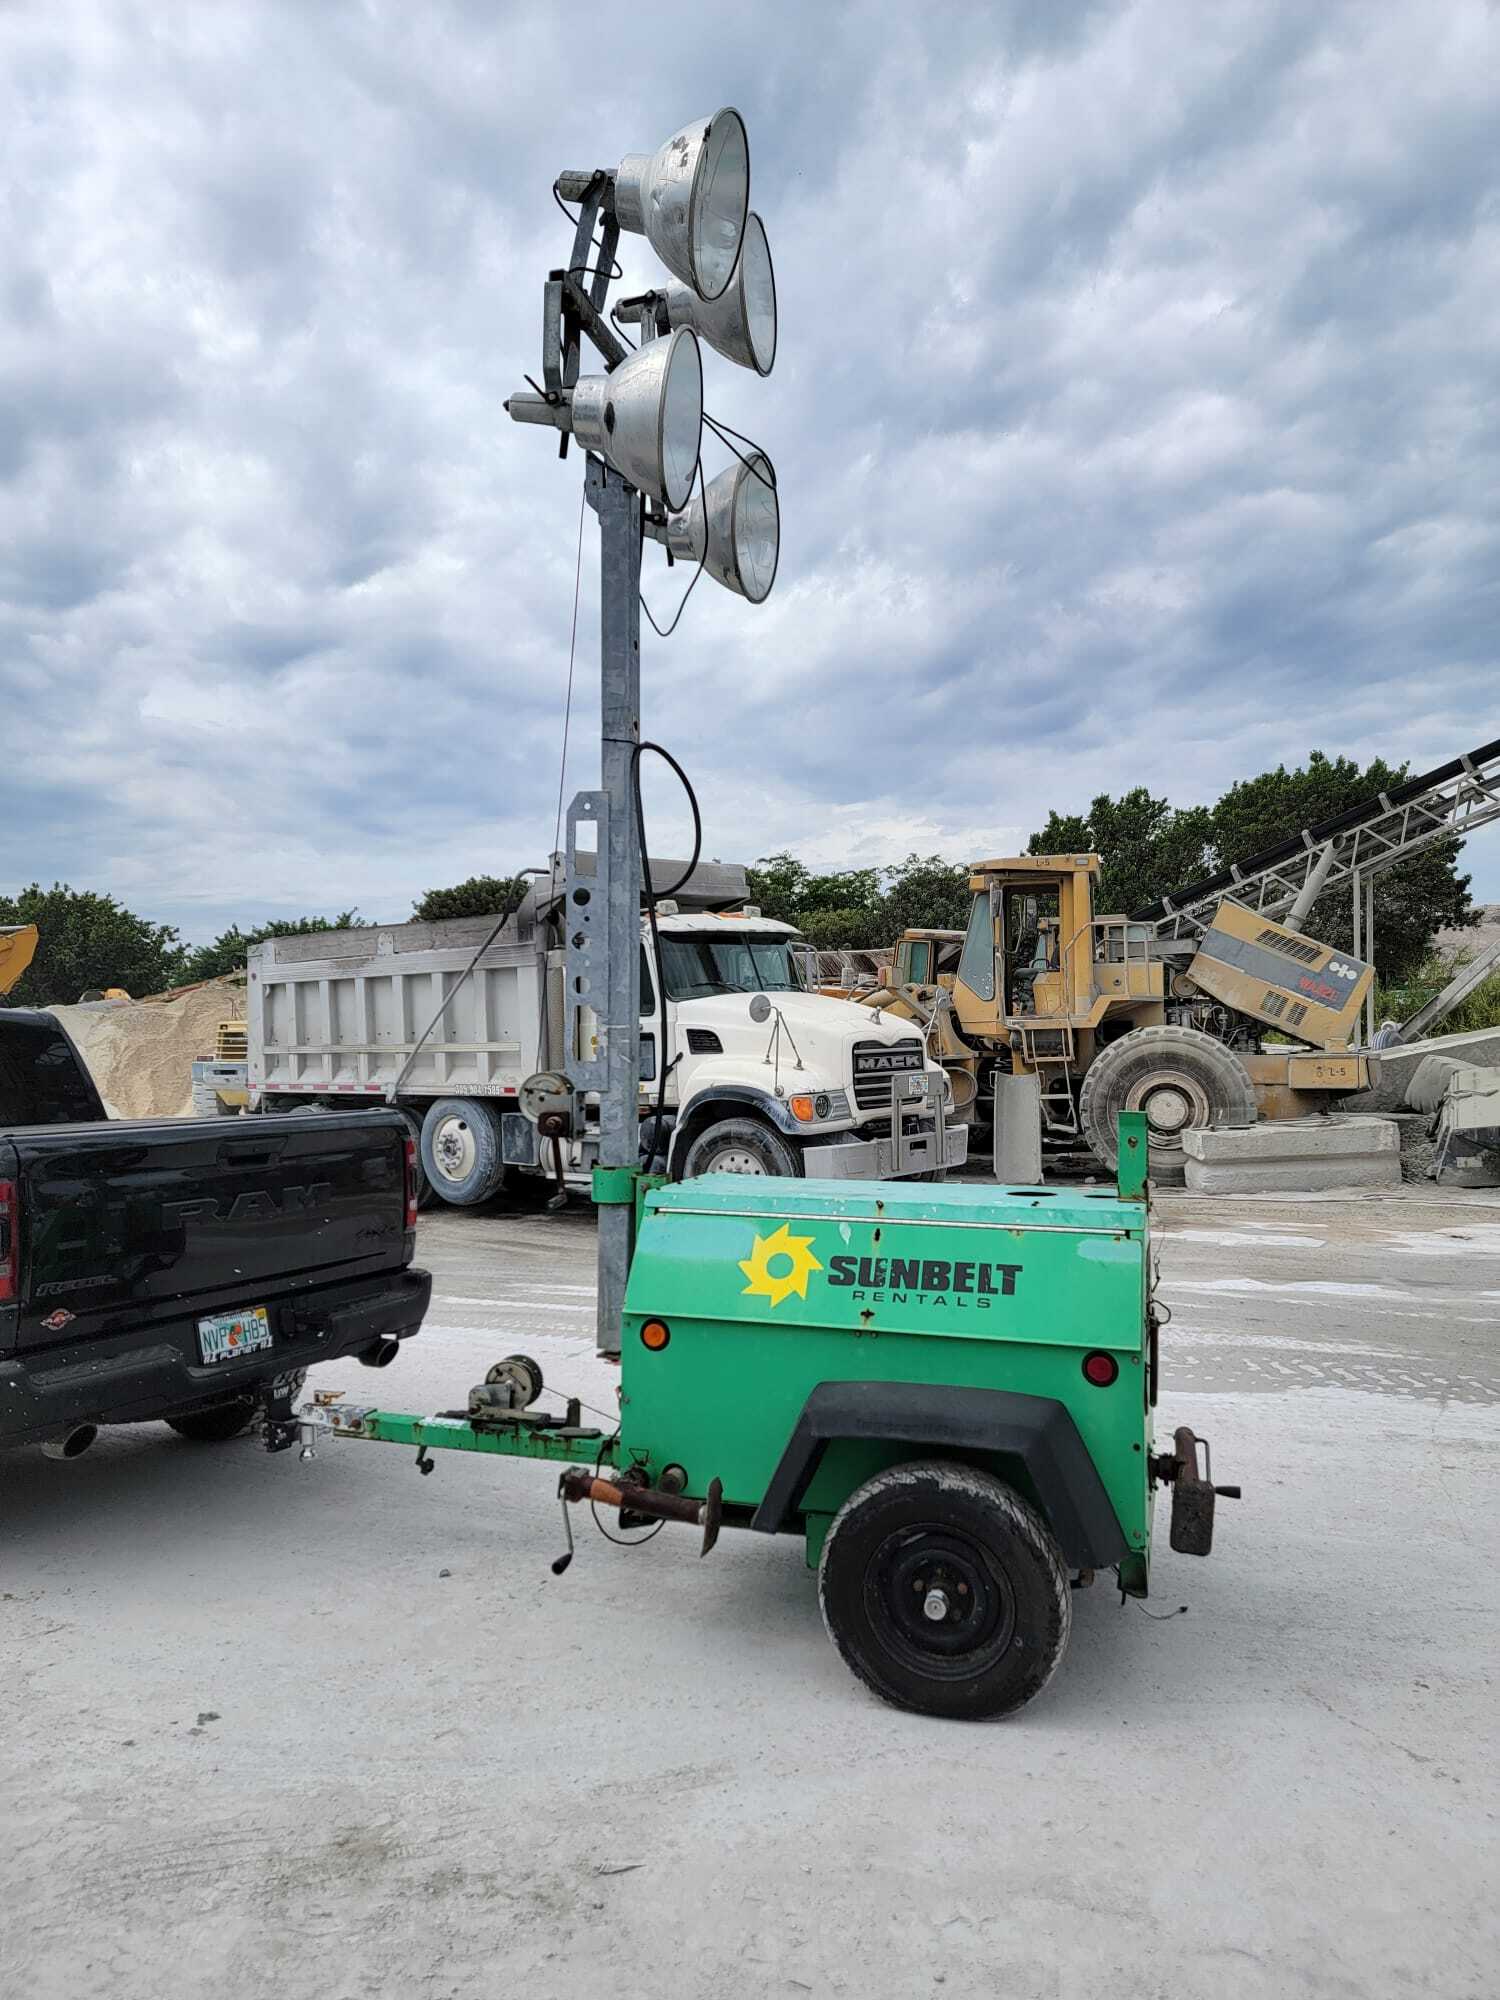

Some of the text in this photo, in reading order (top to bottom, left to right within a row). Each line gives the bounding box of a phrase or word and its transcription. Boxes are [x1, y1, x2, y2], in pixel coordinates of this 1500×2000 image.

[857, 1054, 920, 1071] MACK
[160, 1182, 333, 1231] RAM
[828, 1255, 1024, 1296] SUNBELT
[852, 1290, 992, 1309] RENTALS
